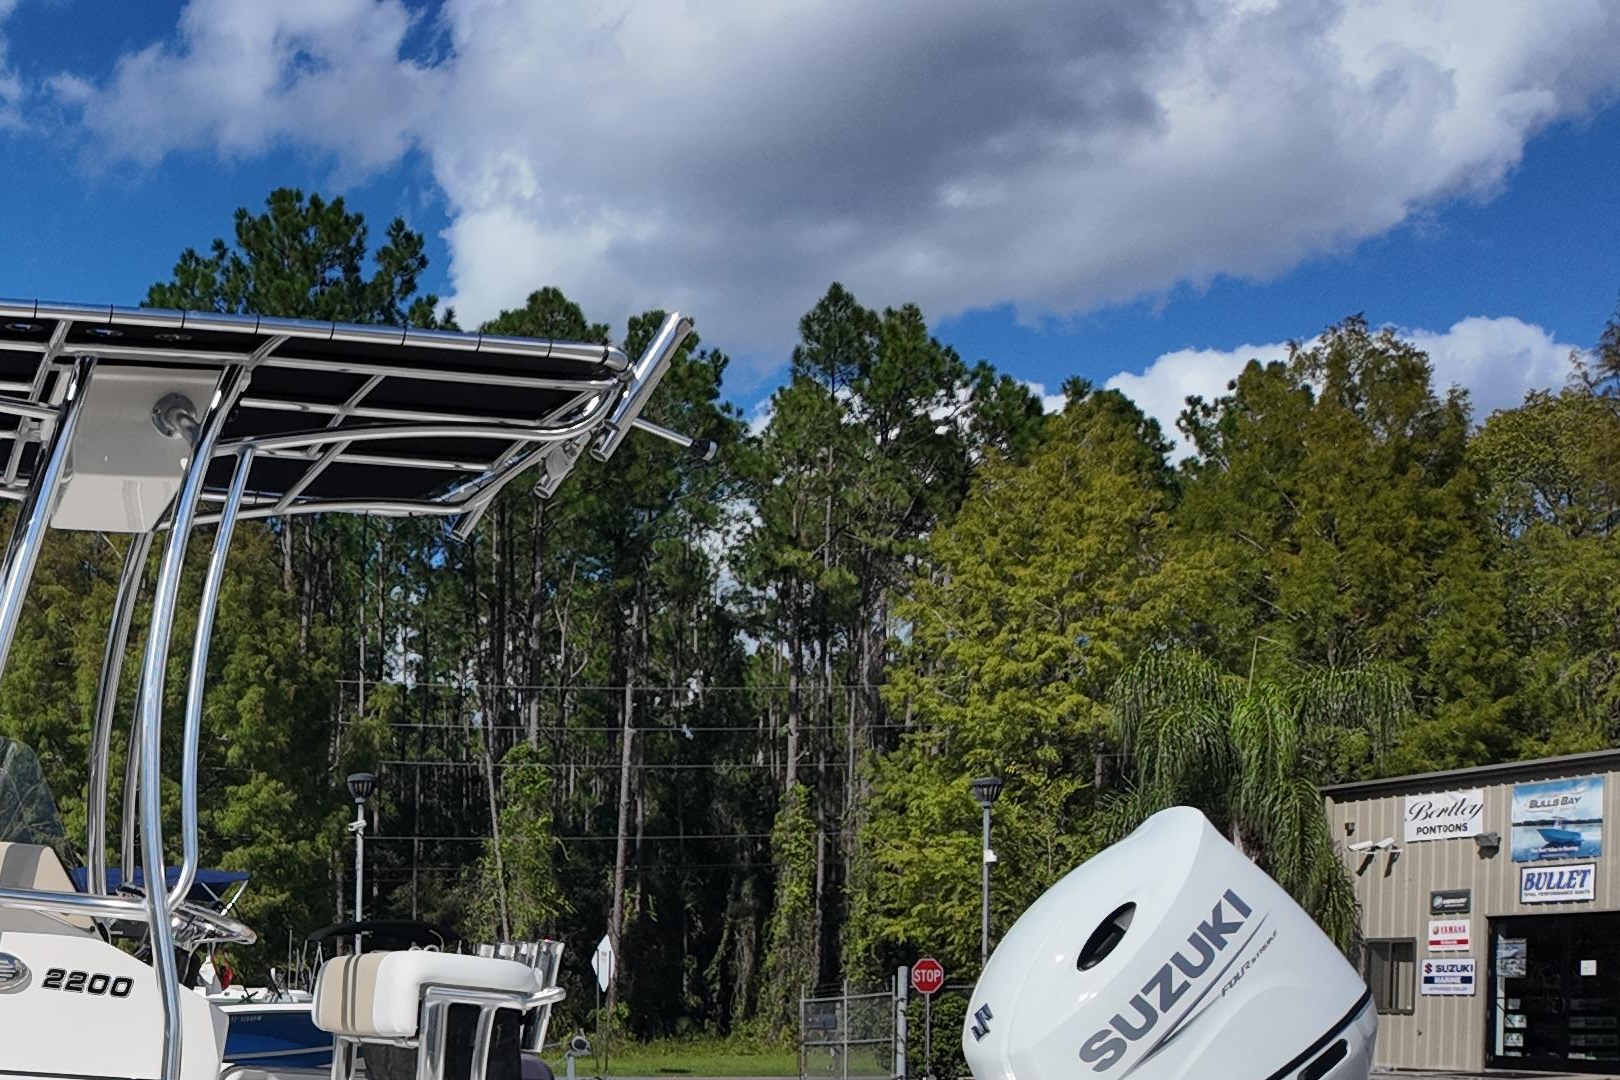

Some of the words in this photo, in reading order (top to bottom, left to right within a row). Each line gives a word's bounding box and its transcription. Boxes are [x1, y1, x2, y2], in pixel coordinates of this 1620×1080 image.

[1408, 798, 1484, 821] Bentley
[1528, 798, 1559, 809] BULLS
[1560, 796, 1582, 806] BAY
[1416, 822, 1468, 836] PONTOONS
[1523, 868, 1592, 891] BULLET
[1440, 924, 1466, 934] YAMAHA
[1435, 964, 1474, 973] SUZUKI
[41, 967, 135, 998] 2200
[914, 969, 942, 983] STOP
[1079, 888, 1253, 1073] SUZUKI
